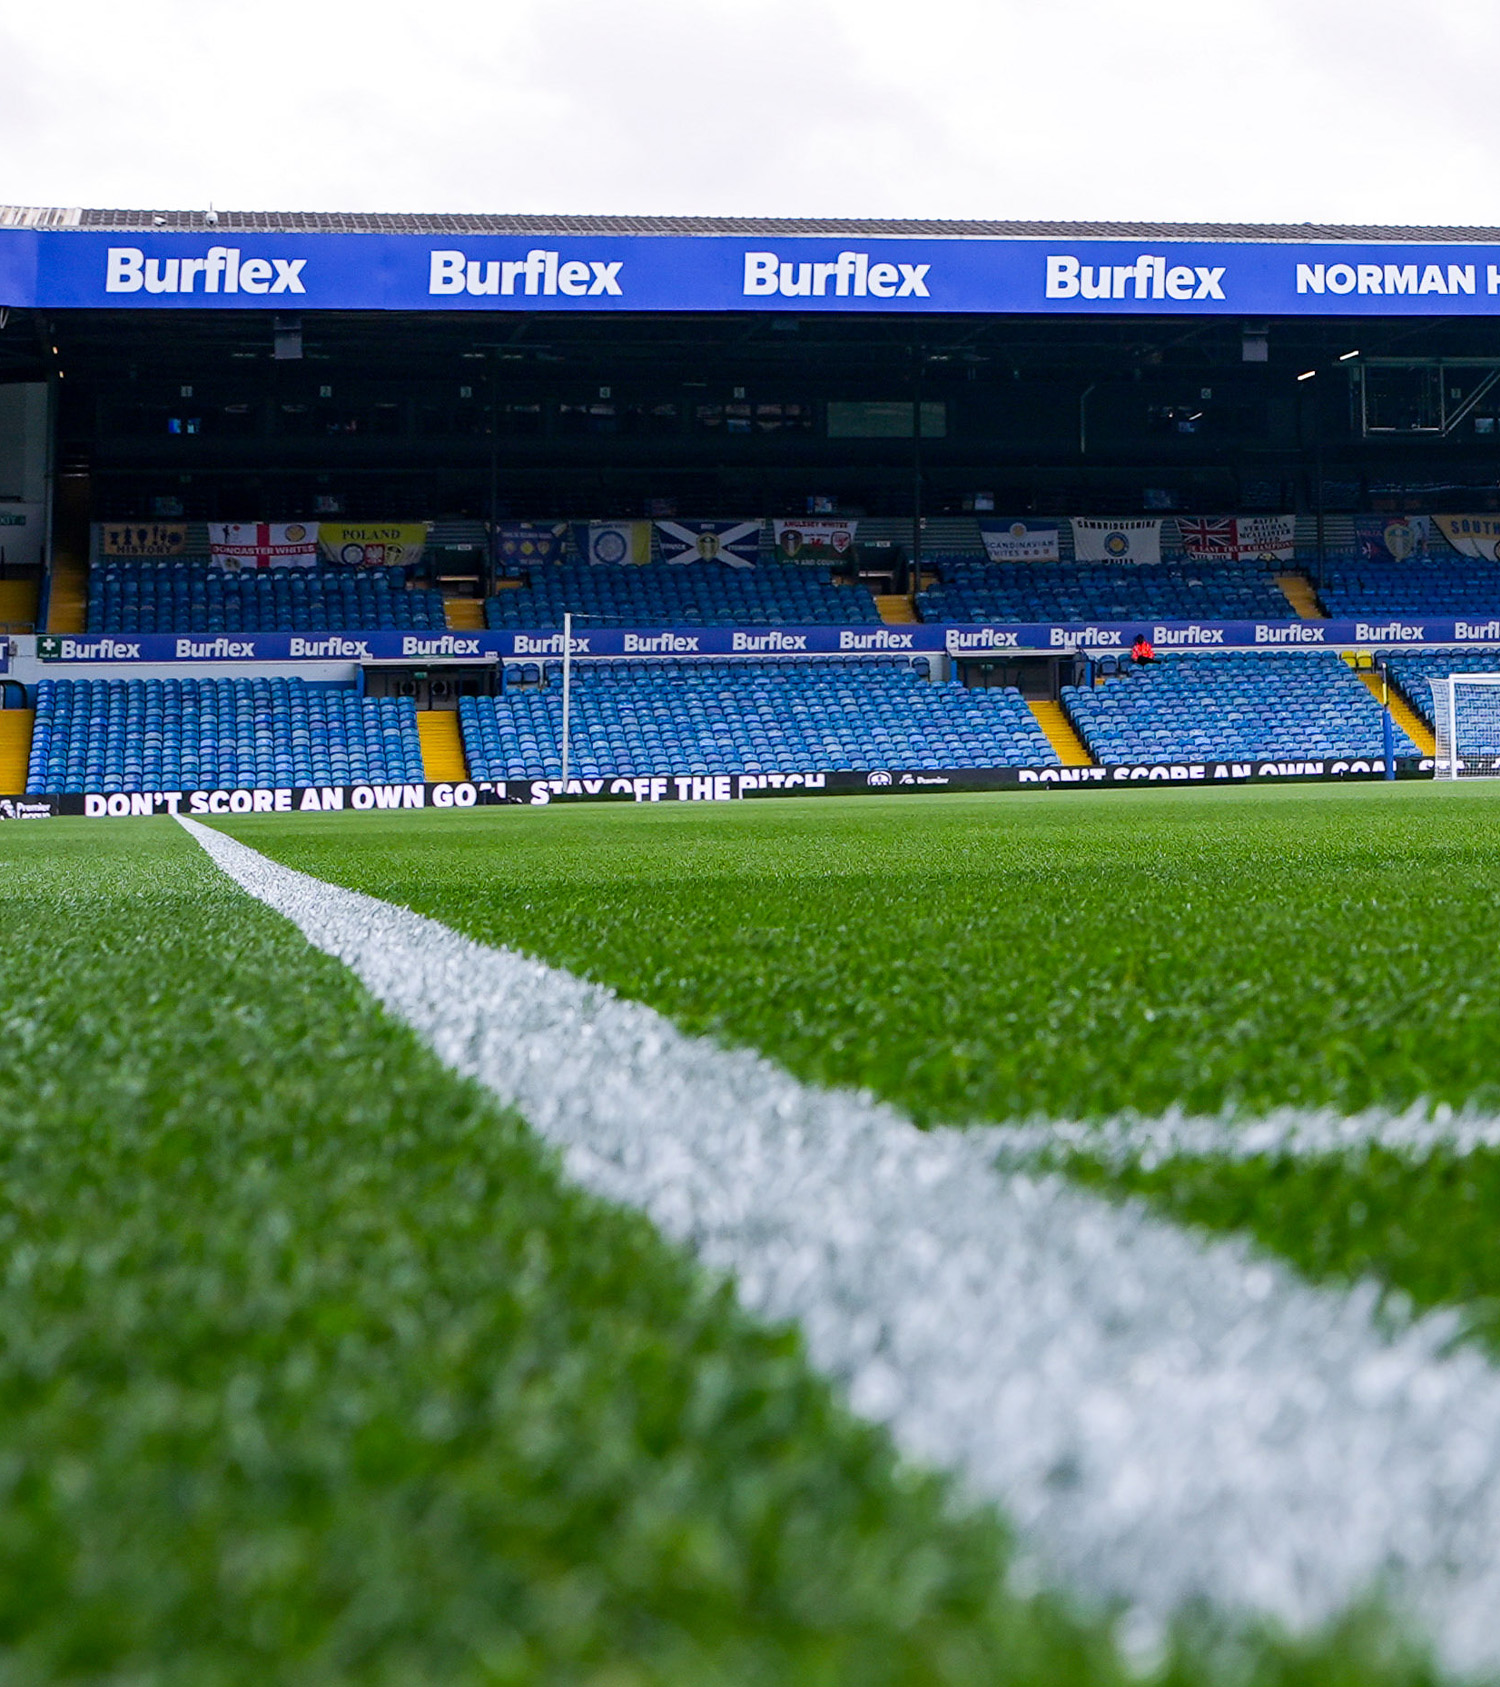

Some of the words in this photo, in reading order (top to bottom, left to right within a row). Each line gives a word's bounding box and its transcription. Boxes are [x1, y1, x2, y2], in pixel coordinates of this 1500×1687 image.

[106, 247, 307, 293] Burflex
[429, 250, 623, 295] Burflex
[744, 252, 930, 297] Burflex
[1046, 255, 1225, 299] Burflex
[1297, 264, 1475, 294] NORMAN
[342, 529, 399, 540] POLAND
[1077, 520, 1157, 531] CAMBRIDGESHIRE
[1450, 519, 1500, 535] SOUTH
[276, 544, 315, 554] WHITES
[986, 540, 1054, 549] SCANDINAVIAN
[840, 630, 912, 648] Burflex
[946, 629, 1017, 647] Burflex
[1051, 627, 1121, 645] Burflex
[1154, 626, 1223, 644] Burflex
[1256, 624, 1324, 642] Burflex
[1356, 623, 1423, 640] Burflex
[61, 640, 140, 658] Burflex
[176, 638, 254, 657] Burflex
[290, 637, 367, 656] Burflex
[403, 636, 479, 653] Burflex
[625, 633, 698, 651] Burflex
[733, 632, 806, 650] Burflex
[84, 791, 182, 818] DON'T
[190, 788, 292, 814] SCORE
[300, 786, 344, 812] AN
[350, 783, 425, 811] OWN
[432, 781, 507, 807] GOL
[530, 780, 604, 806] STAY
[610, 778, 667, 803] OFF
[674, 776, 731, 801] THE
[16, 801, 51, 812] Premier
